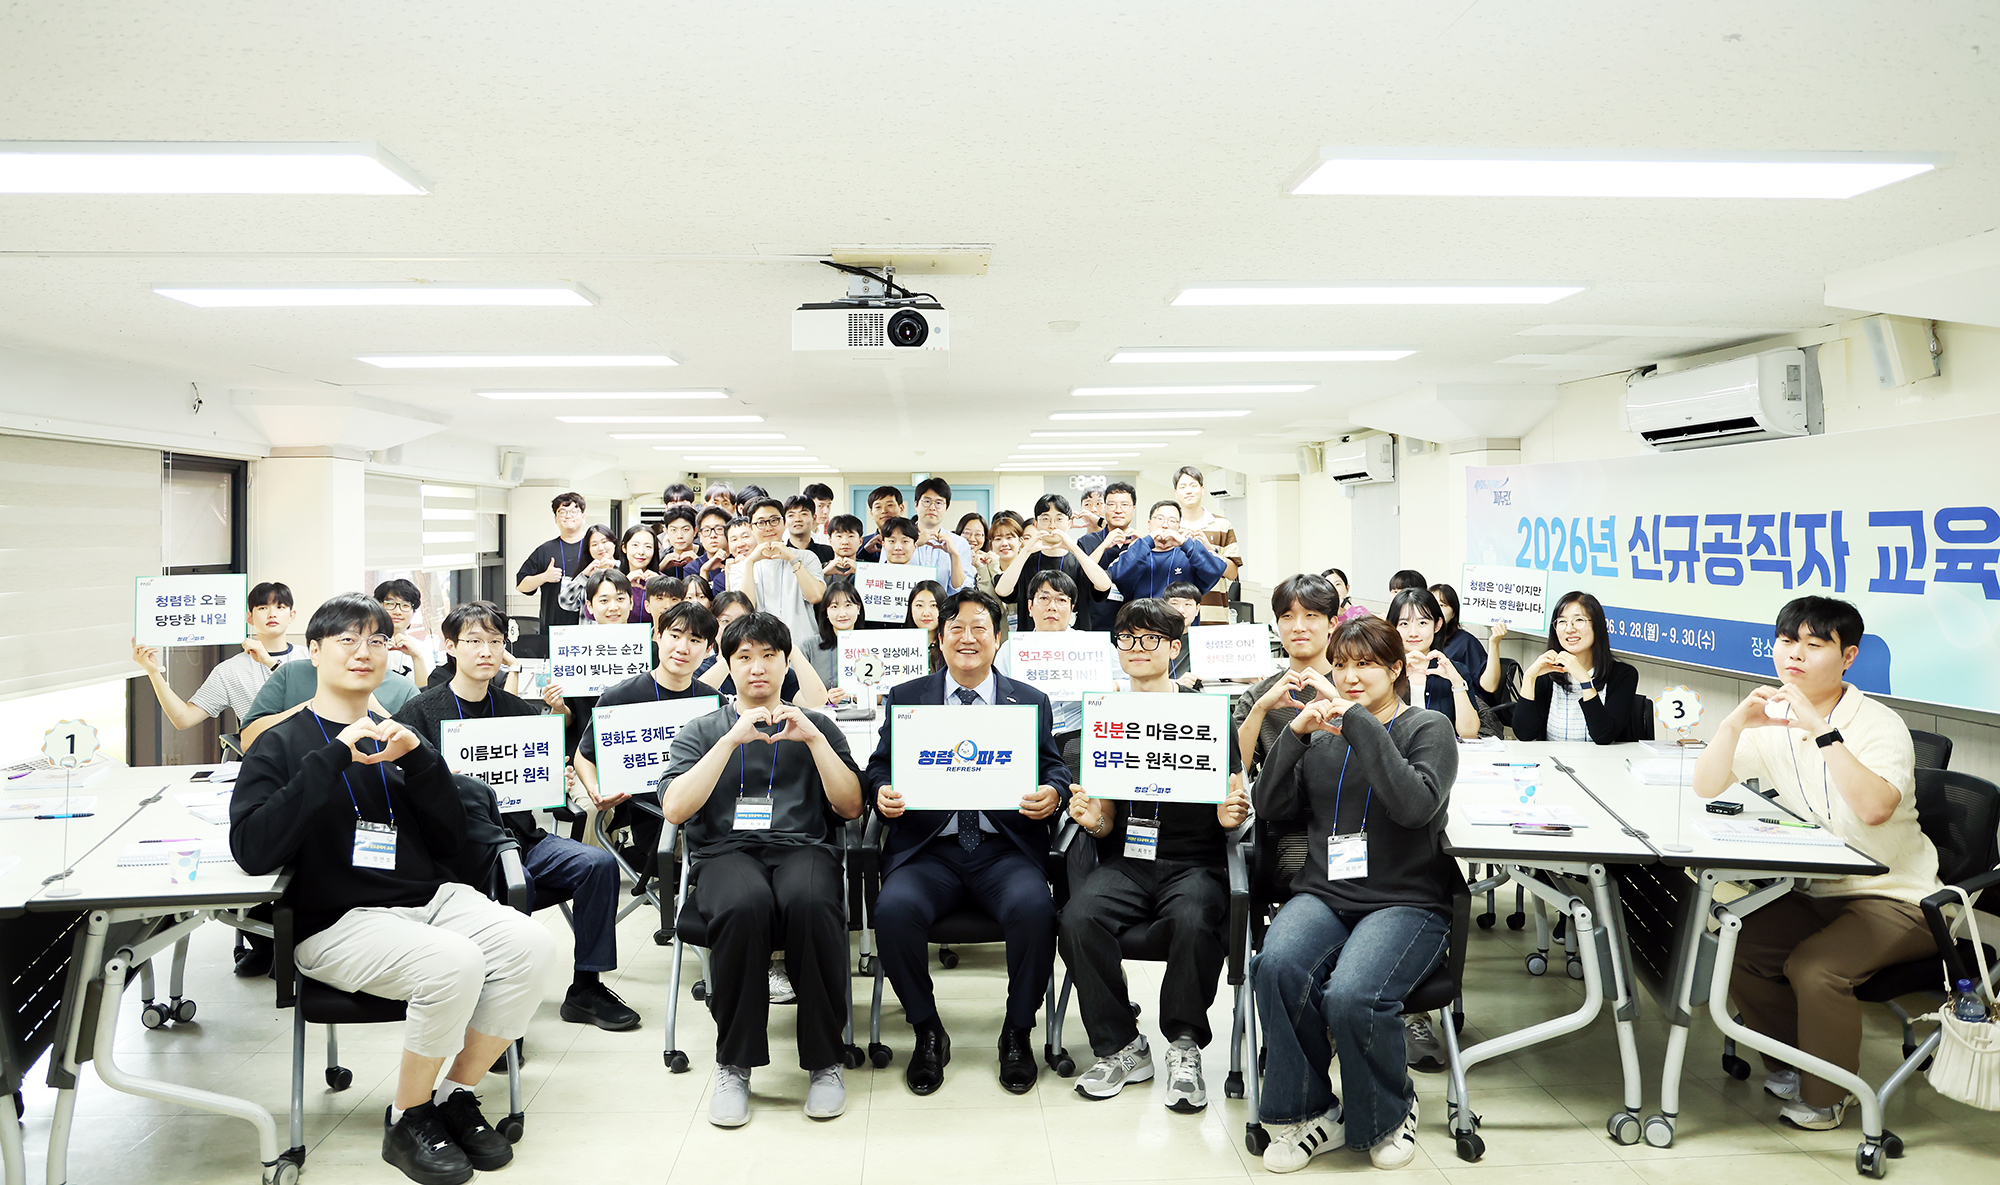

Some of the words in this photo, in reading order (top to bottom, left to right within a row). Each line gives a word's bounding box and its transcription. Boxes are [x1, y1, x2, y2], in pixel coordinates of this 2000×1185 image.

[1516, 515, 1619, 578] 2026년
[1628, 510, 1850, 593] 신규공직자
[1868, 506, 2000, 600] 교육
[865, 579, 893, 590] 부패는
[1470, 580, 1494, 593] 청렴은
[156, 595, 196, 608] 청렴한
[200, 594, 227, 606] 오늘
[864, 594, 892, 606] 청렴은
[1462, 596, 1471, 606] 그
[1472, 598, 1497, 610] 가치는
[1499, 599, 1544, 614] 영원합니다.
[155, 614, 196, 627] 당당한
[201, 613, 227, 625] 내일
[1619, 620, 1628, 636] 9.
[1629, 621, 1660, 643] 28.(월)
[1669, 627, 1679, 644] 9.
[1682, 629, 1716, 651] 30.(수)
[558, 645, 592, 658] 파주가
[595, 644, 618, 657] 웃는
[621, 643, 643, 656] 순간
[1205, 639, 1234, 649] 청렴은
[1236, 639, 1255, 648] ON!
[1019, 650, 1065, 662] 연고주의
[1068, 651, 1103, 662] OUT!!
[1207, 654, 1235, 663] 청탁은
[1237, 653, 1256, 662] NO!
[553, 665, 587, 678] 청렴이
[590, 664, 624, 676] 빛나는
[626, 662, 650, 675] 순간
[864, 663, 873, 677] 2
[1026, 669, 1072, 681] 청렴조직
[1076, 670, 1097, 680] IN!!
[1672, 700, 1685, 719] 3
[601, 730, 638, 747] 평화도
[641, 726, 675, 743] 경제도
[1093, 721, 1141, 740] 친분은
[1146, 722, 1217, 743] 마음으로,
[66, 734, 75, 754] 1
[460, 743, 518, 762] 이름보다
[522, 741, 549, 758] 실력
[623, 752, 659, 769] 청렴도
[918, 750, 955, 765] 청렴
[976, 750, 1013, 765] 파주
[1092, 751, 1140, 769] 업무는
[1146, 752, 1217, 772] 원칙으로.
[522, 766, 549, 783] 원칙
